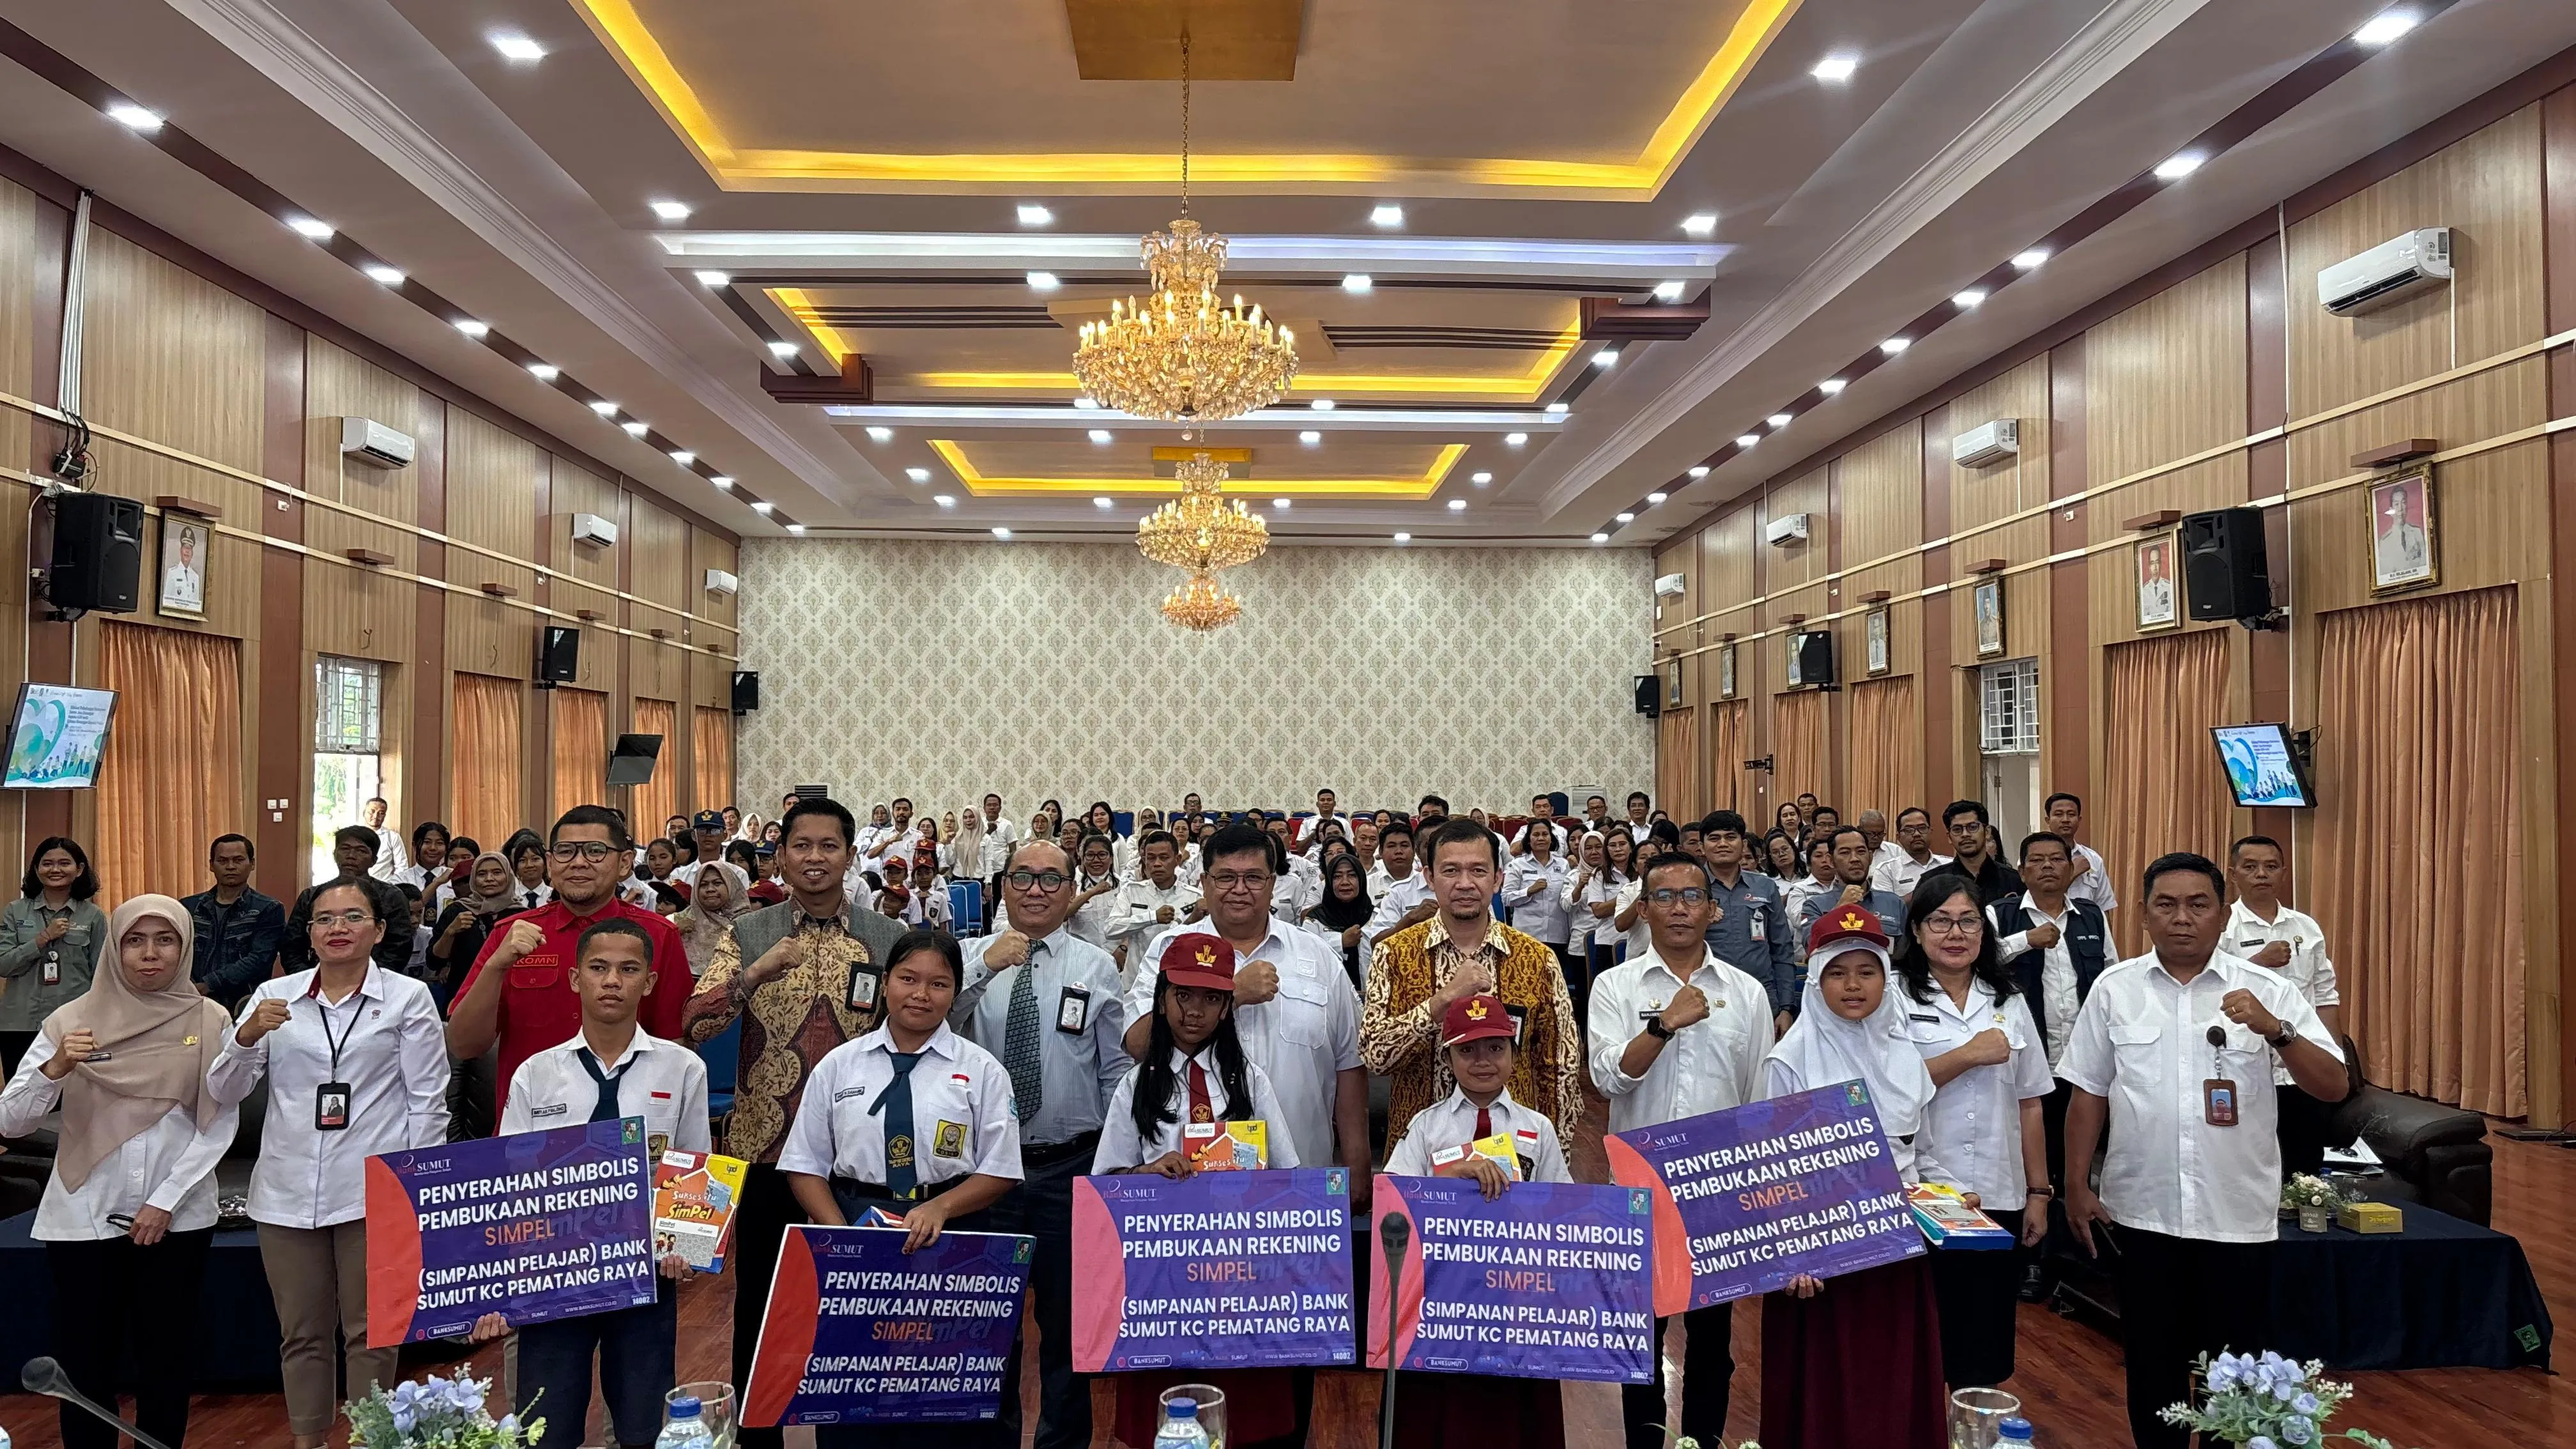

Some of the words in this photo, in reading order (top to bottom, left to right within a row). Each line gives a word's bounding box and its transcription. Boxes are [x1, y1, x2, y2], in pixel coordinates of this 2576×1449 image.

[1655, 1133, 1687, 1149] SUMUT
[1664, 1137, 1787, 1179] PENYERAHAN
[1789, 1117, 1874, 1150] SIMBOLIS
[417, 1158, 451, 1172] SUMUT
[1203, 1158, 1230, 1170] Sukses
[1669, 1162, 1788, 1203] PEMBUKAAN
[1788, 1140, 1880, 1176] REKENING
[419, 1170, 548, 1206] PENYERAHAN
[551, 1157, 639, 1186] SIMBOLIS
[673, 1190, 702, 1200] Sukses
[1123, 1188, 1156, 1199] SUMUT
[1423, 1191, 1457, 1201] SUMUT
[1738, 1181, 1809, 1211] SIMPEL
[418, 1196, 540, 1232] PEMBUKAAN
[544, 1182, 638, 1213] REKENING
[666, 1202, 712, 1220] SimPel
[485, 1217, 555, 1246] SIMPEL
[1124, 1213, 1250, 1233] PENYERAHAN
[1255, 1208, 1342, 1229] SIMBOLIS
[1424, 1217, 1551, 1241] PENYERAHAN
[1556, 1223, 1644, 1246] SIMBOLIS
[1686, 1221, 1780, 1259] (SIMPANAN
[1781, 1200, 1857, 1233] PELAJAR)
[1858, 1192, 1905, 1215] BANK
[831, 1245, 864, 1255] SUMUT
[1123, 1237, 1242, 1259] PEMBUKAAN
[1247, 1234, 1341, 1255] REKENING
[1690, 1250, 1747, 1276] SUMUT
[1749, 1245, 1774, 1263] KC
[1775, 1223, 1866, 1257] PEMATANG
[1867, 1212, 1914, 1236] RAYA
[418, 1257, 516, 1292] (SIMPANAN
[519, 1243, 596, 1272] PELAJAR)
[601, 1239, 647, 1260] BANK
[1422, 1242, 1542, 1266] PEMBUKAAN
[1547, 1248, 1642, 1271] REKENING
[825, 1271, 942, 1291] PENYERAHAN
[944, 1274, 1021, 1293] SIMBOLIS
[1186, 1261, 1257, 1282] SIMPEL
[1485, 1269, 1556, 1292] SIMPEL
[417, 1286, 477, 1310] SUMUT
[480, 1282, 503, 1301] KC
[507, 1268, 600, 1296] PEMATANG
[604, 1261, 649, 1282] RAYA
[817, 1297, 929, 1316] PEMBUKAAN
[931, 1299, 1013, 1318] REKENING
[1121, 1296, 1216, 1319] (SIMPANAN
[1220, 1291, 1298, 1315] PELAJAR)
[1302, 1292, 1349, 1310] BANK
[1419, 1297, 1514, 1321] (SIMPANAN
[1518, 1306, 1597, 1330] PELAJAR)
[1601, 1311, 1648, 1329] BANK
[433, 1324, 466, 1335] BANKSUMUT
[871, 1321, 933, 1340] SIMPEL
[1119, 1321, 1177, 1338] SUMUT
[1181, 1320, 1204, 1337] KC
[1208, 1317, 1301, 1336] PEMATANG
[1305, 1315, 1351, 1333] RAYA
[1416, 1322, 1475, 1341] SUMUT
[1478, 1326, 1502, 1342] KC
[1505, 1328, 1599, 1348] PEMATANG
[1603, 1333, 1649, 1351] RAYA
[804, 1353, 893, 1376] (SIMPANAN
[894, 1353, 963, 1375] PELAJAR)
[966, 1356, 1006, 1371] BANK
[1333, 1352, 1351, 1361] 14002
[1430, 1358, 1462, 1367] BANKSUMUT
[797, 1378, 854, 1395] SUMUT
[854, 1377, 877, 1393] KC
[878, 1377, 960, 1393] PEMATANG
[962, 1377, 1000, 1392] RAYA
